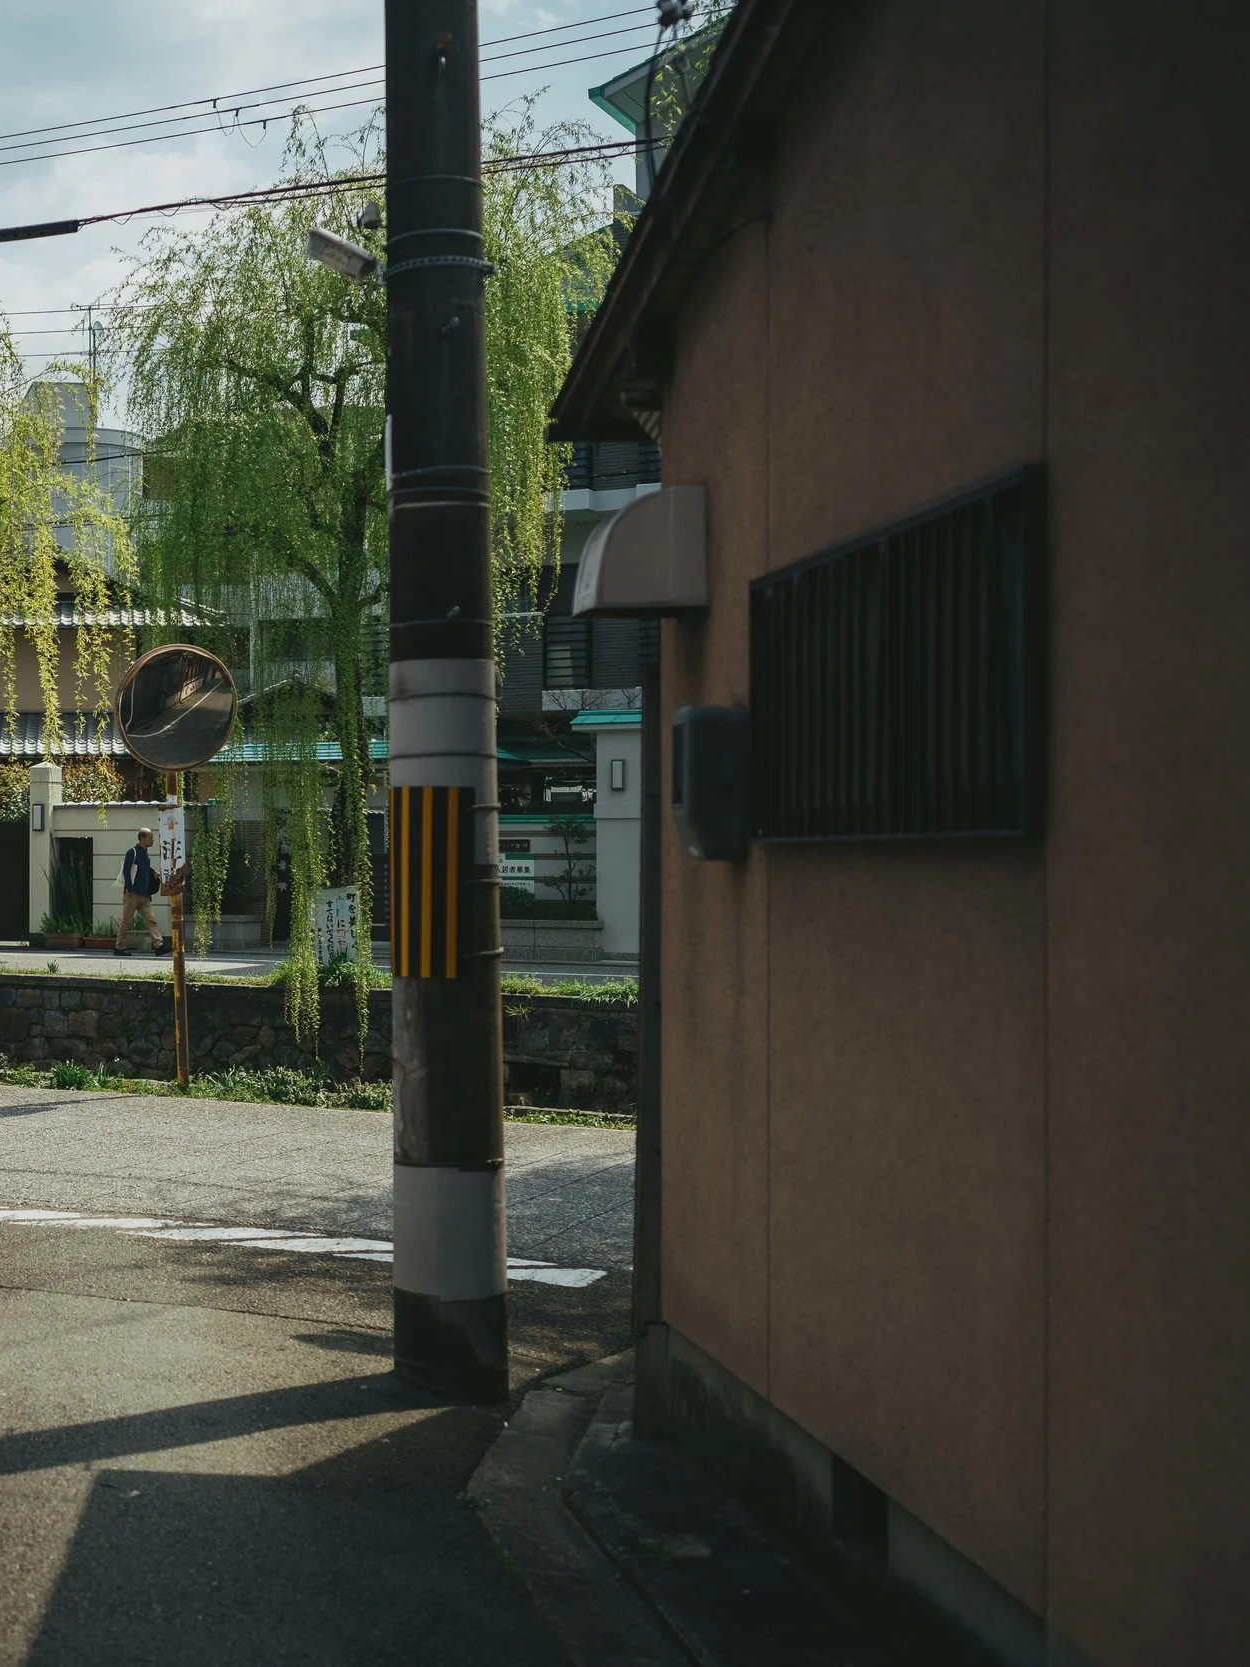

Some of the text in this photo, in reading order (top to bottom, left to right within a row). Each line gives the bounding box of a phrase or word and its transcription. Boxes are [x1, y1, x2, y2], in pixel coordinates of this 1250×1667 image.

[326, 900, 334, 965] すてないでくだ
